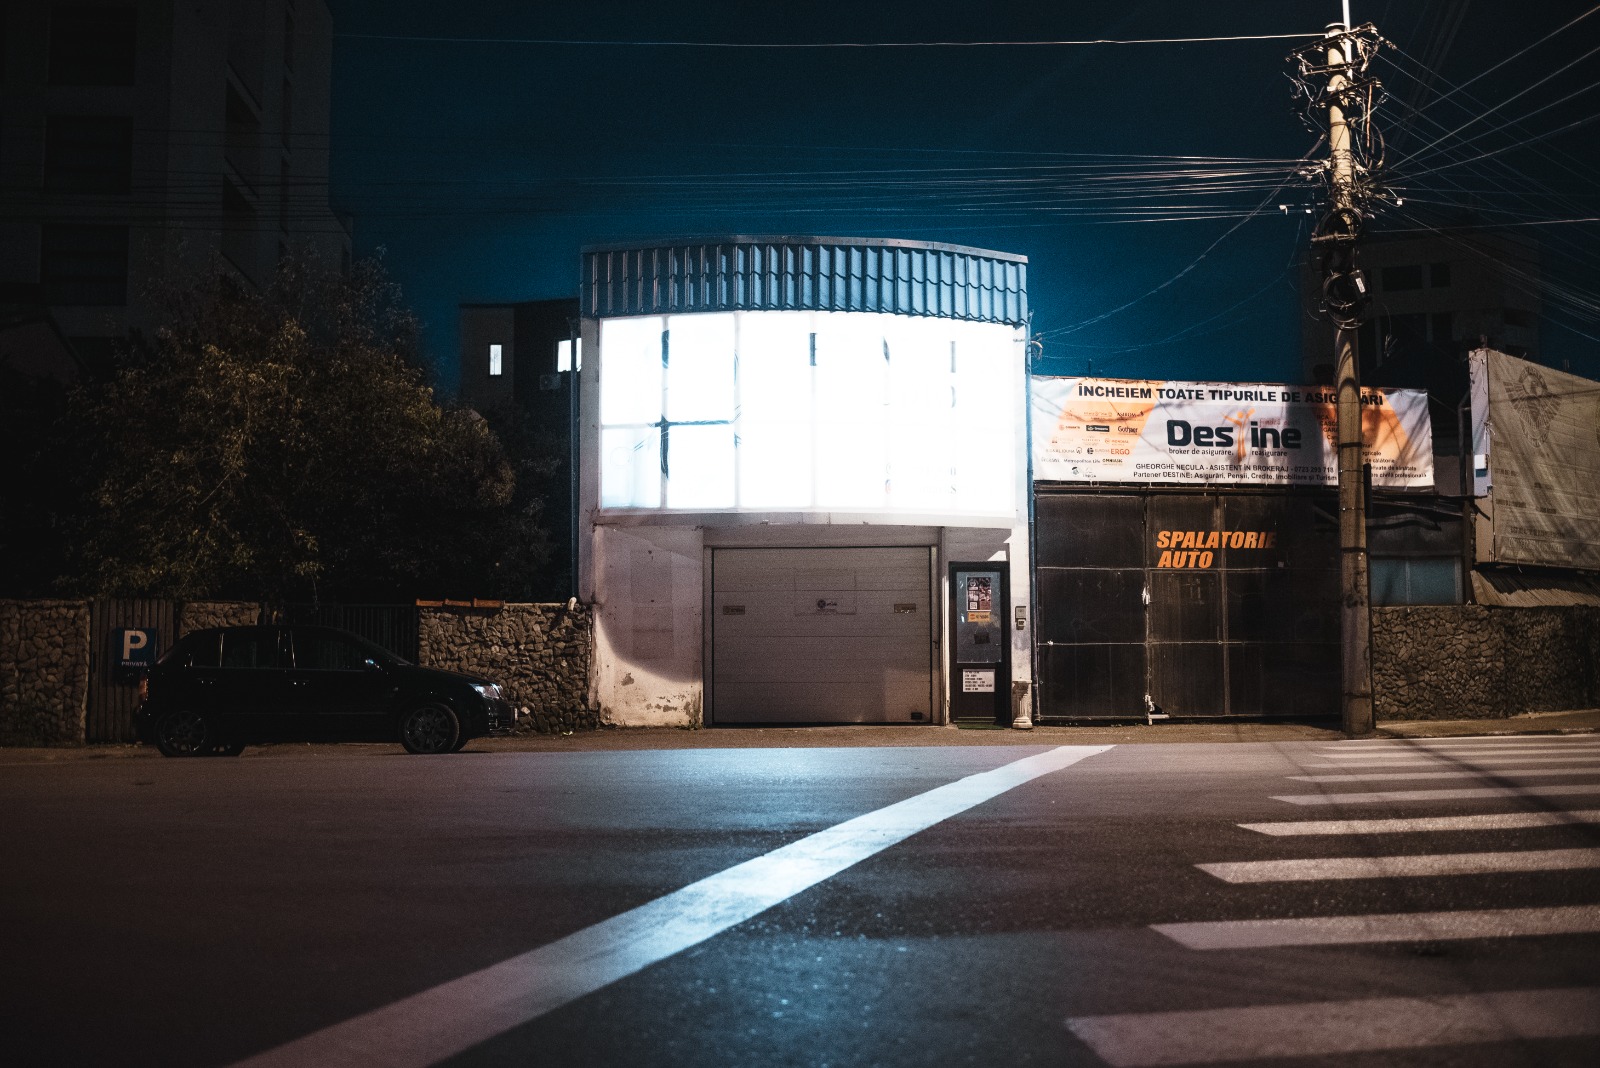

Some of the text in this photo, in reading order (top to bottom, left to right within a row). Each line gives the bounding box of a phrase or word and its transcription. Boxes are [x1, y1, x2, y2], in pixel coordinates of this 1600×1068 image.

[1078, 383, 1152, 399] ÎNCHEIEM
[1156, 388, 1205, 400] TOATE
[1208, 389, 1277, 402] TIPURILE
[1281, 391, 1301, 403] DE
[1168, 447, 1190, 455] broker
[1191, 447, 1200, 455] de
[1251, 449, 1288, 458] reasigurare
[1156, 531, 1277, 549] SPALATORIE
[1157, 550, 1214, 569] AUTO
[123, 630, 147, 660] P
